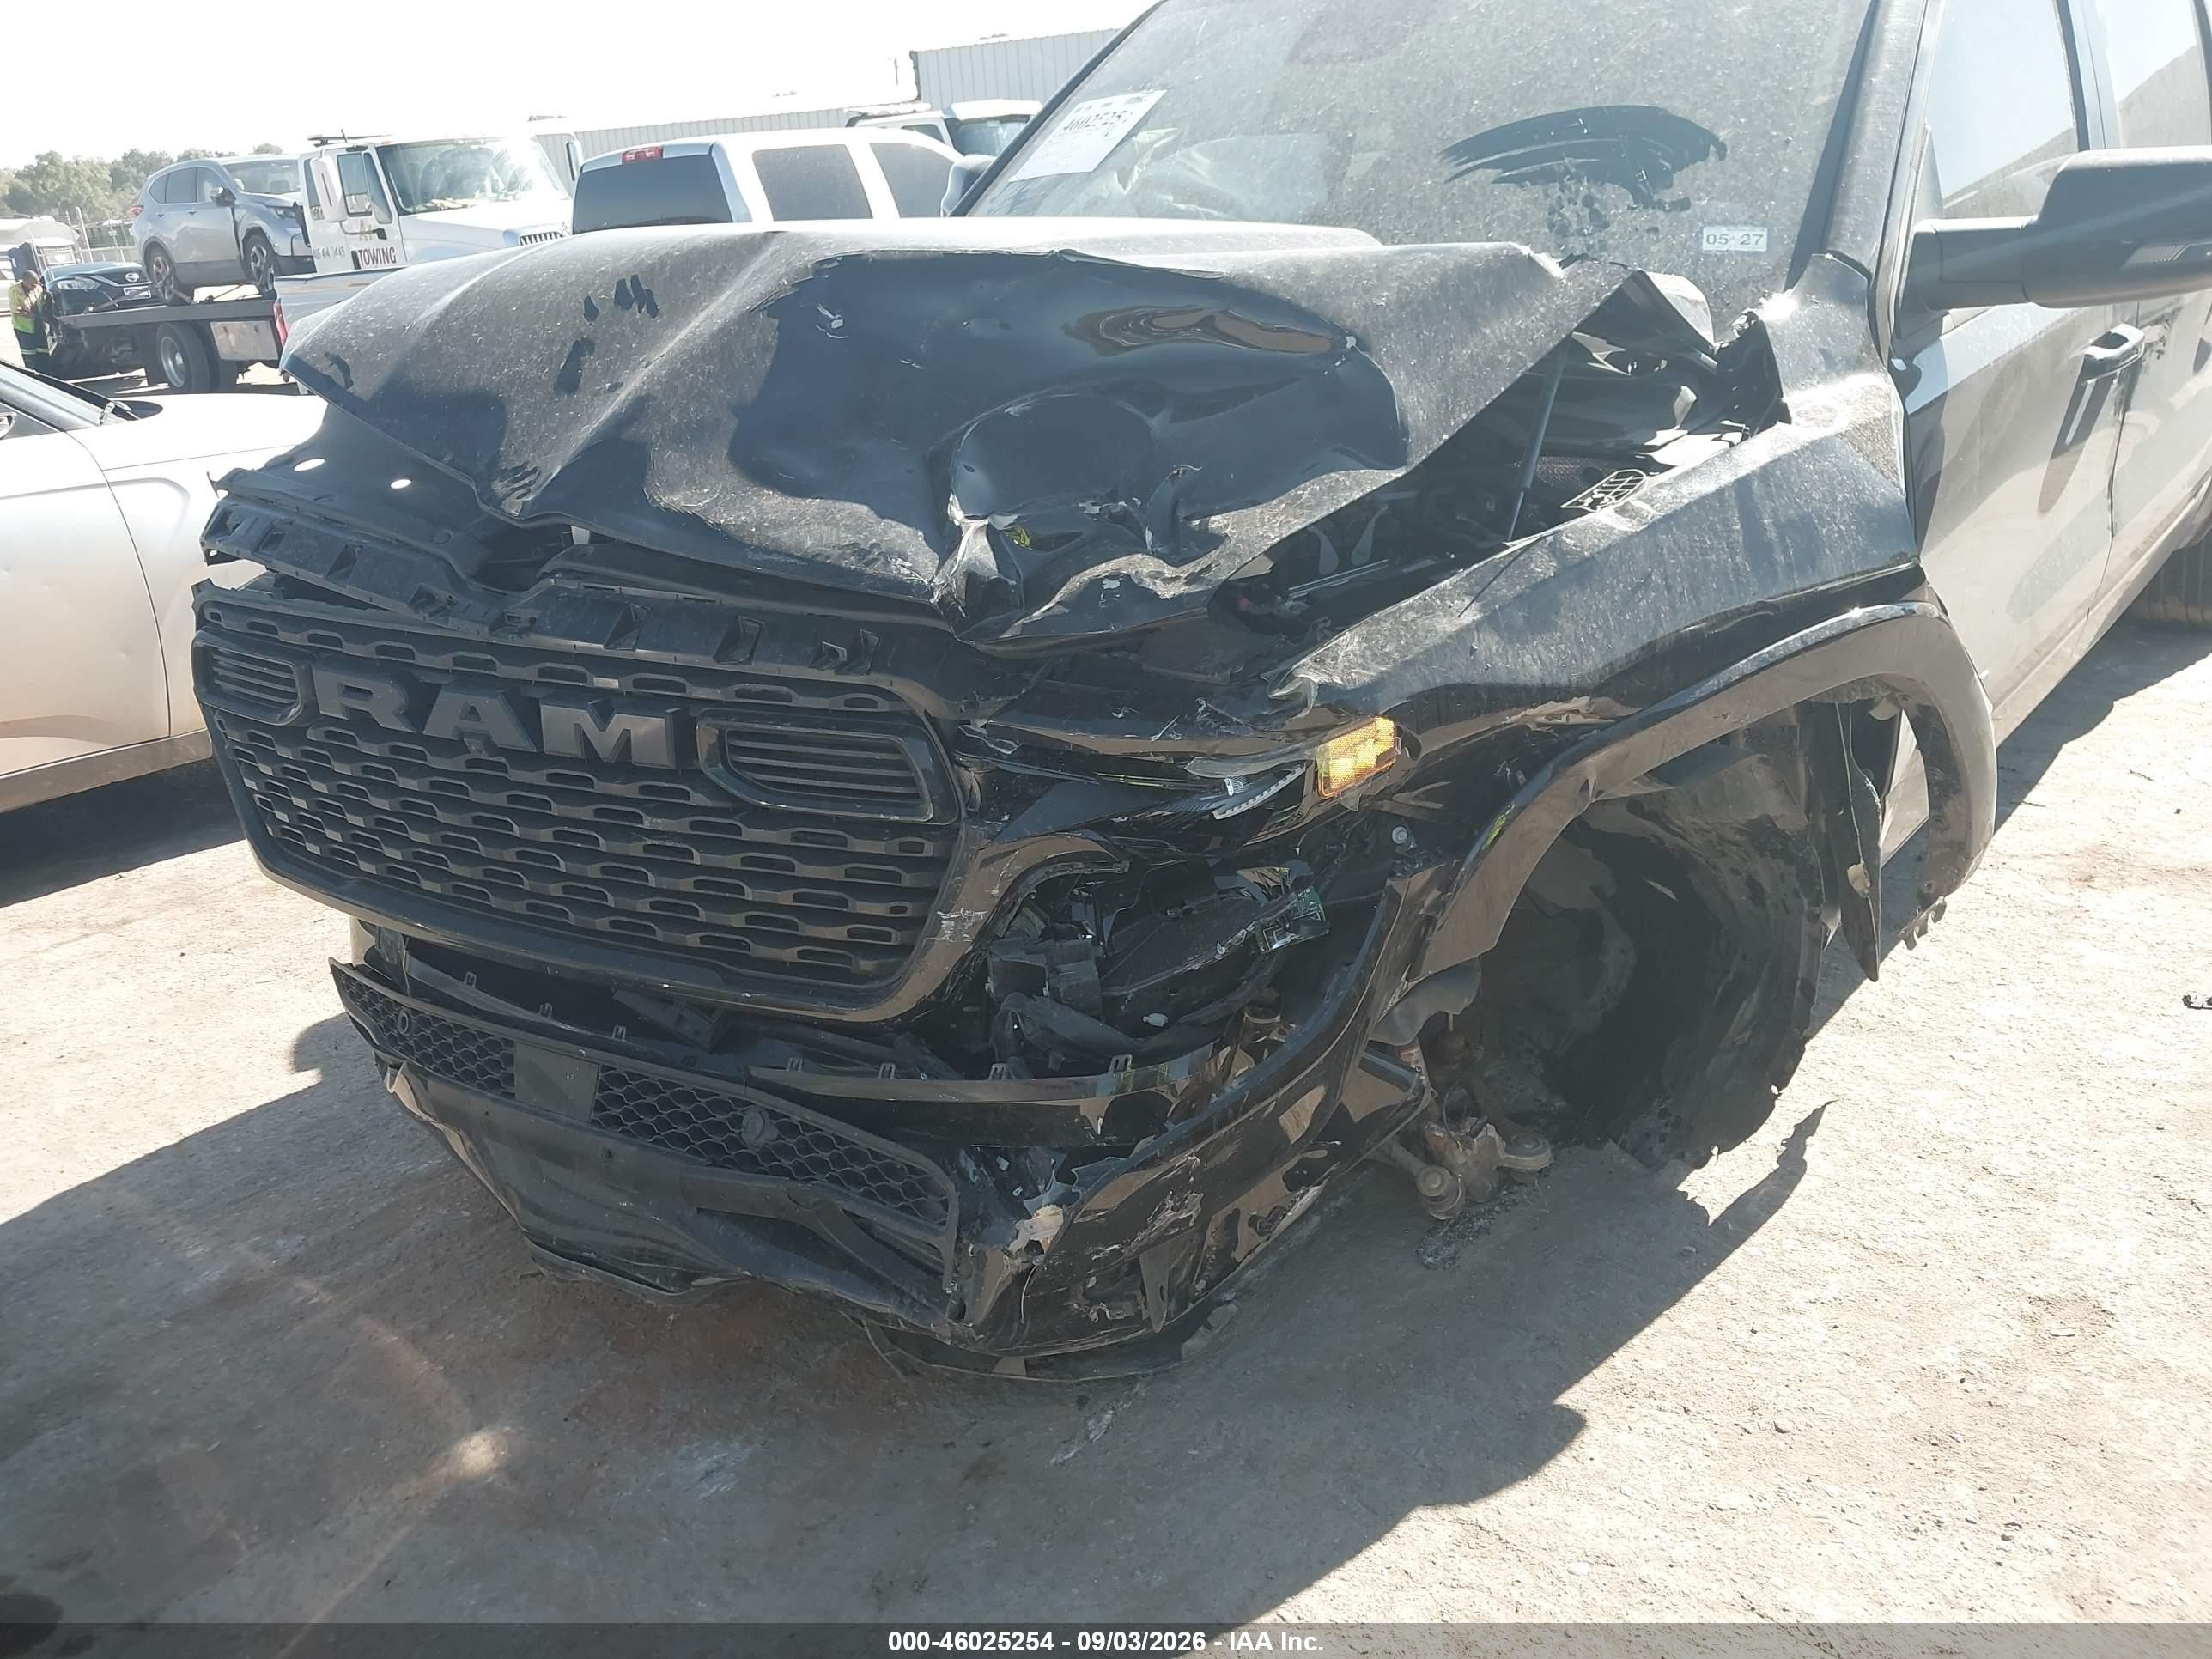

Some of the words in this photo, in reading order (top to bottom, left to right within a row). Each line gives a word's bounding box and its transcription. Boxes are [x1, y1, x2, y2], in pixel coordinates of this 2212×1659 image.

[1705, 233, 1729, 246] 05
[1739, 233, 1764, 246] 27
[358, 246, 397, 266] TOWING
[313, 663, 683, 771] RAM
